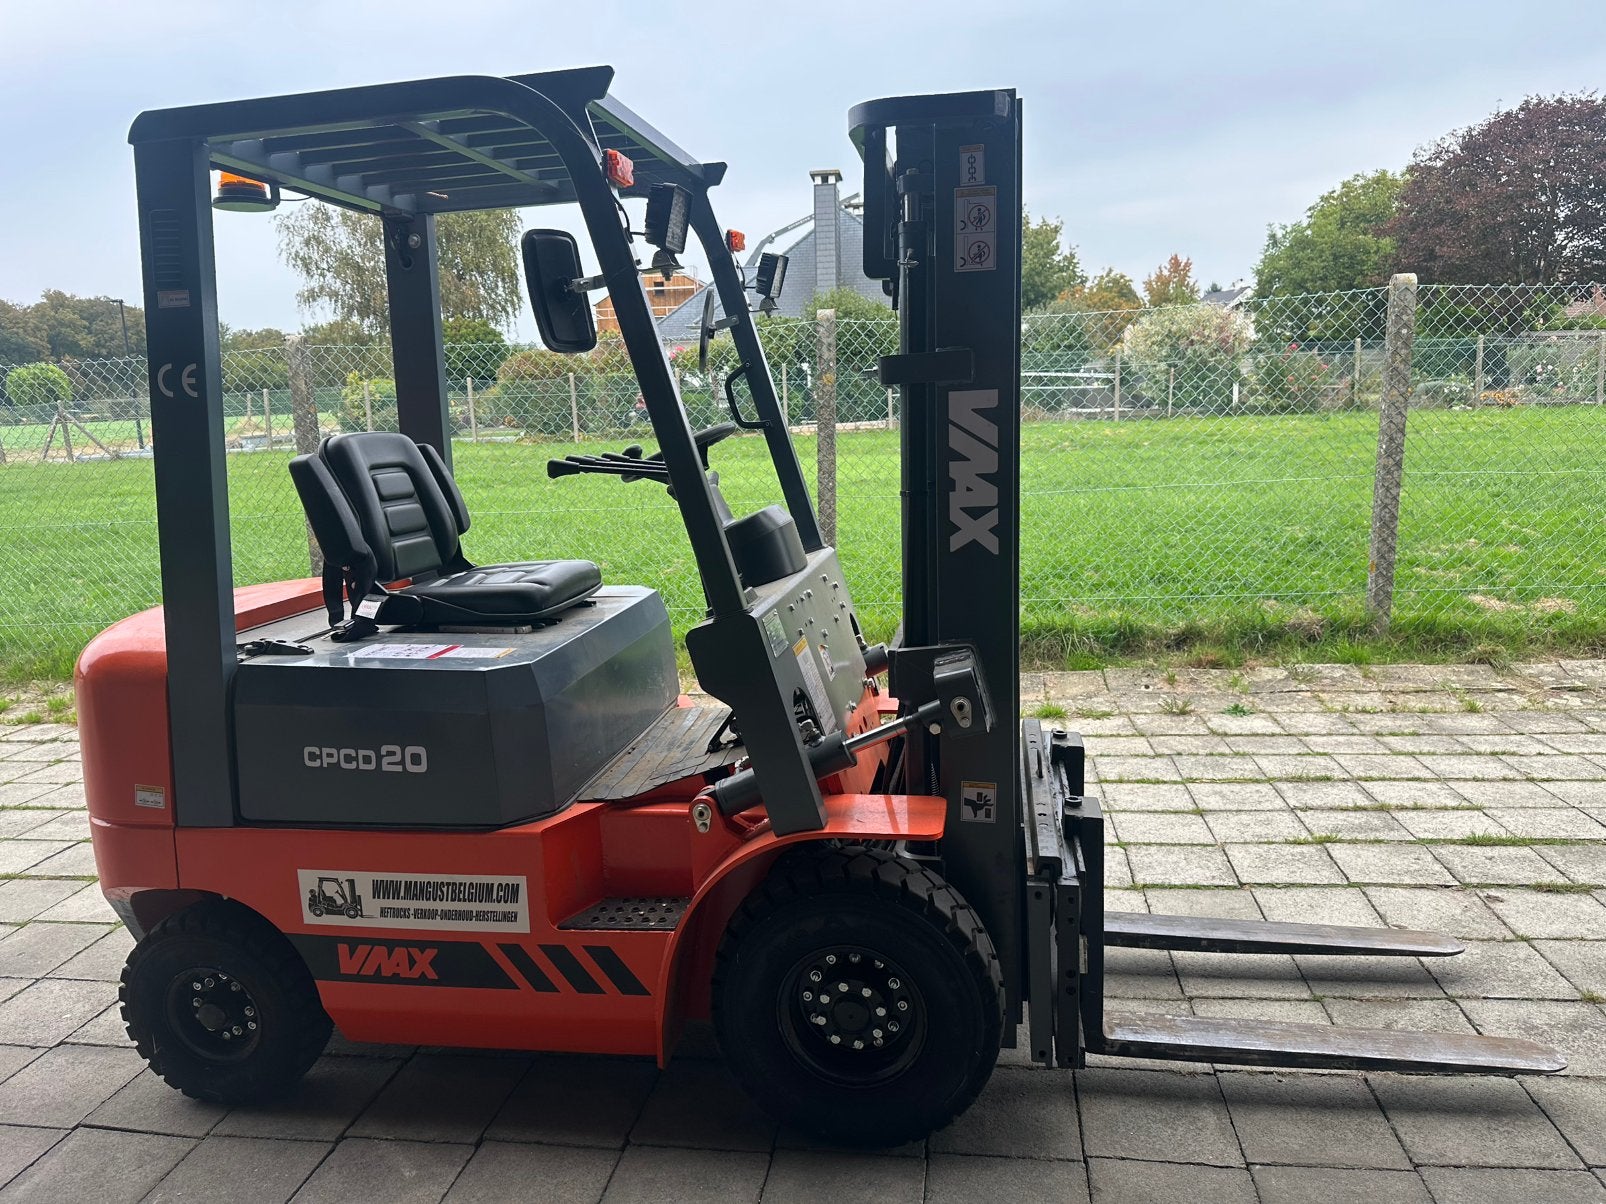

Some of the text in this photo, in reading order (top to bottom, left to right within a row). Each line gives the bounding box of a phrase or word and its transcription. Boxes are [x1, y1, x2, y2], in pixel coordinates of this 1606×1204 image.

[157, 362, 199, 398] CE
[948, 388, 999, 555] VMAX
[371, 879, 520, 904] WWW.MANGUSTBELGIUM.COM
[337, 943, 439, 980] VMAX
